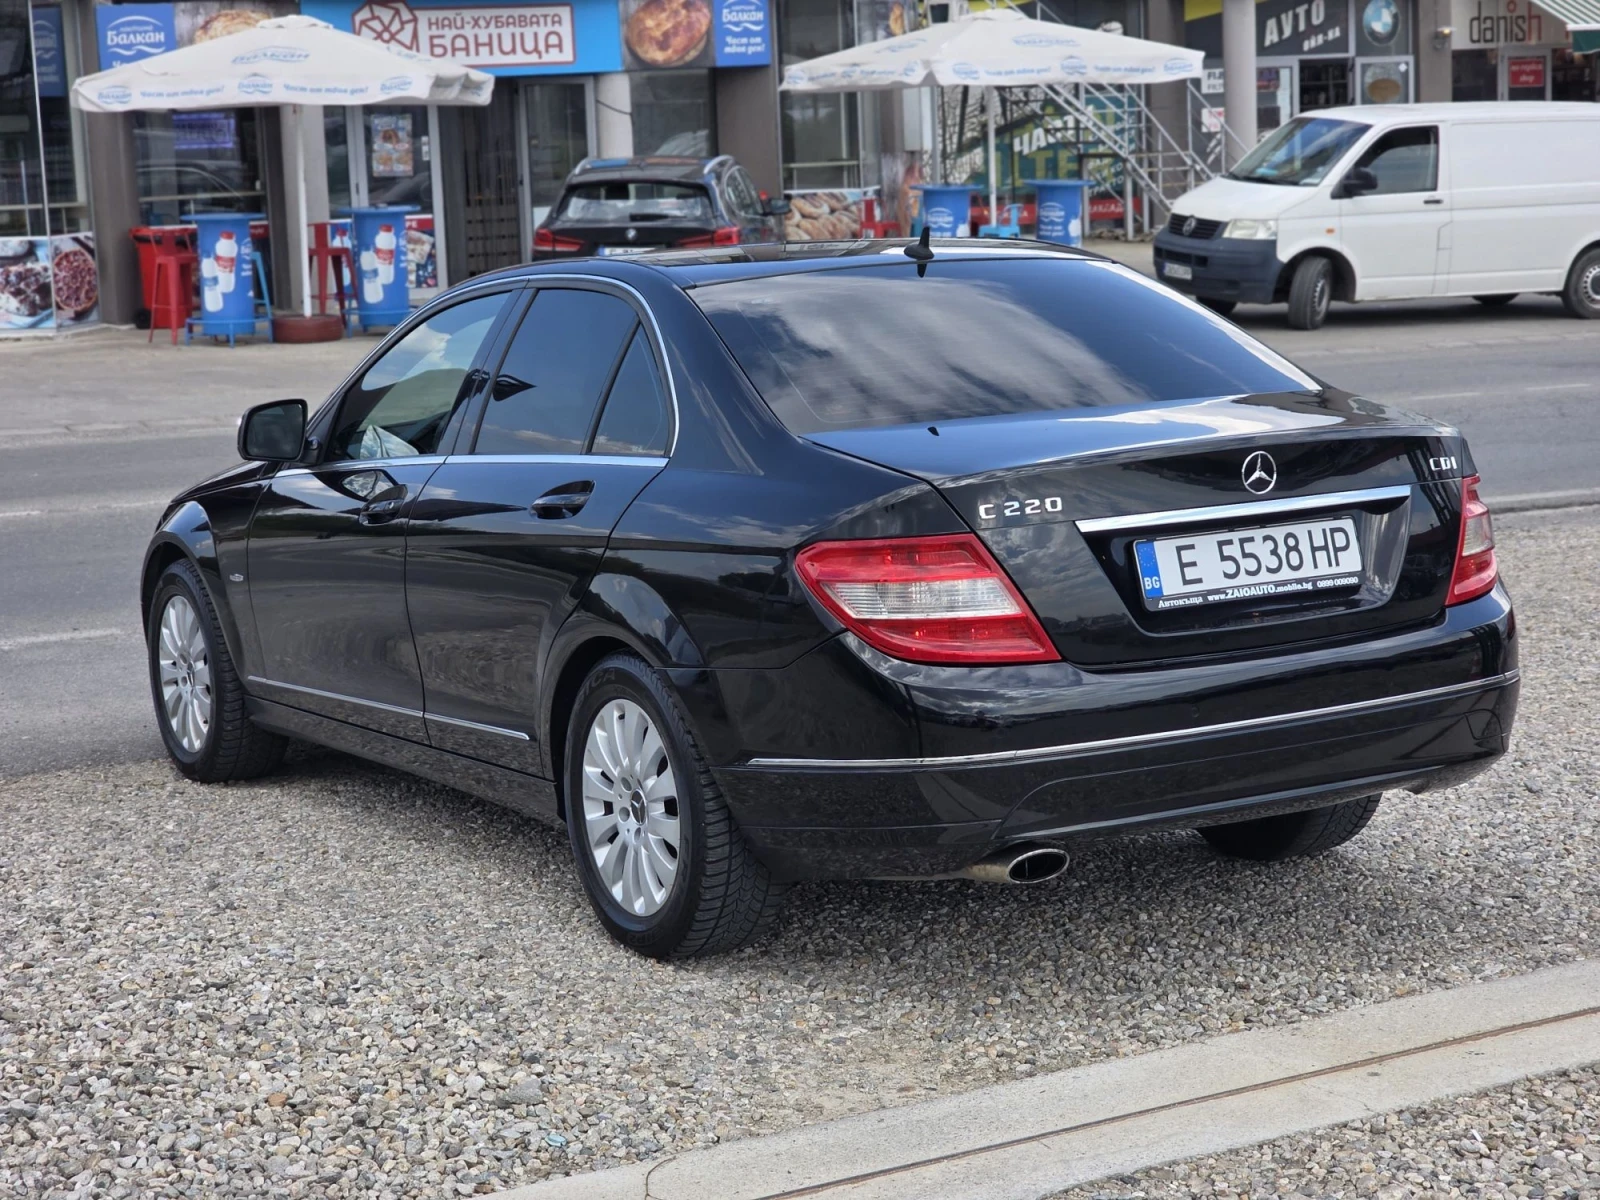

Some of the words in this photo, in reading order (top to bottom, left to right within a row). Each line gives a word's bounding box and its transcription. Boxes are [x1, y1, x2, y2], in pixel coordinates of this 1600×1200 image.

[428, 12, 563, 31] НАЙ-ХУБАВАТА
[722, 8, 765, 23] Балкан
[1469, 0, 1542, 44] danish
[106, 30, 165, 45] Балкан
[429, 31, 564, 59] БАНИЦА
[1429, 456, 1458, 471] CDI
[979, 504, 997, 519] C
[1004, 497, 1063, 517] 220
[1175, 543, 1204, 586] E
[1216, 531, 1304, 580] 5538
[1307, 526, 1351, 570] HP
[1144, 577, 1161, 590] BG
[1157, 596, 1204, 609] Автокъща
